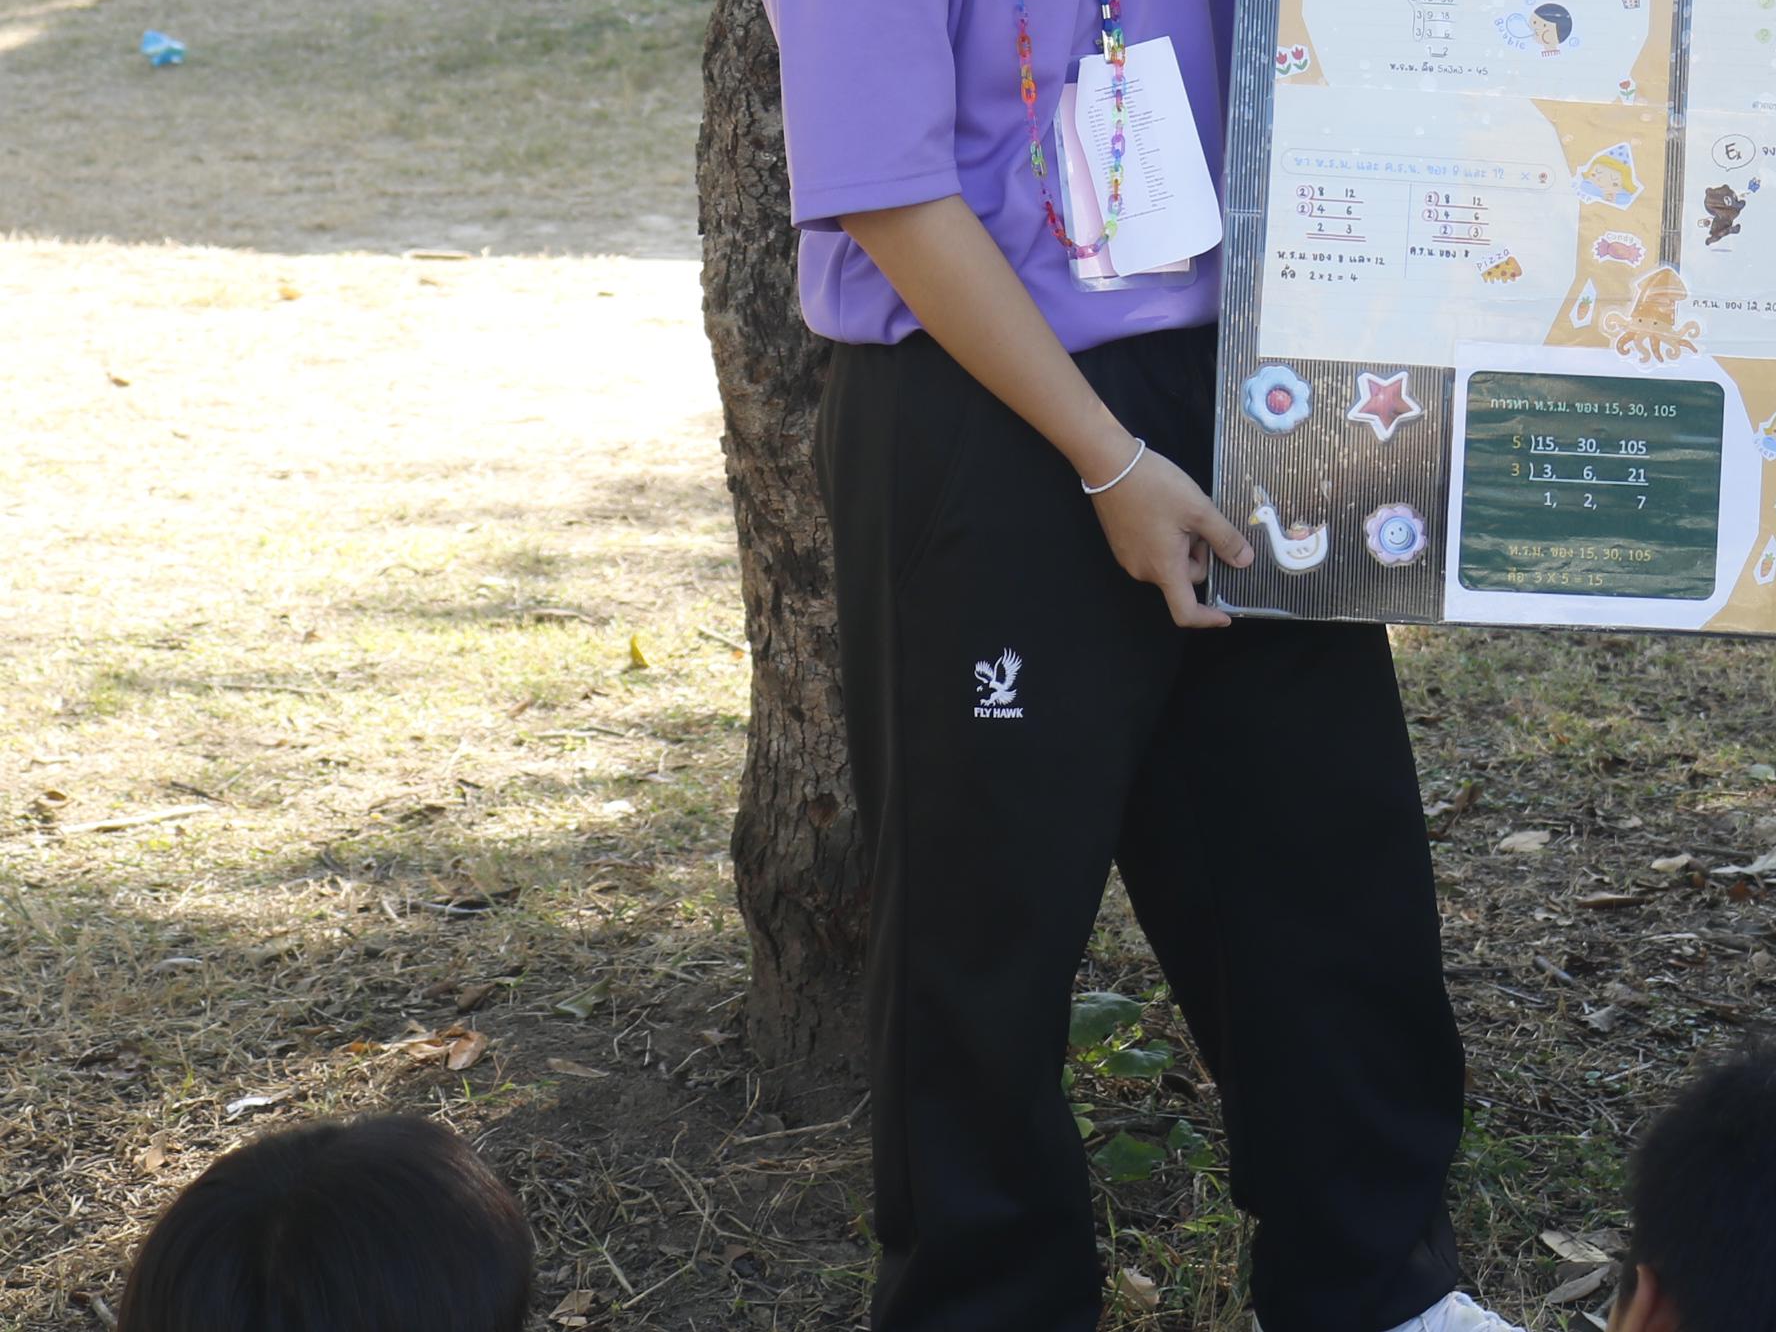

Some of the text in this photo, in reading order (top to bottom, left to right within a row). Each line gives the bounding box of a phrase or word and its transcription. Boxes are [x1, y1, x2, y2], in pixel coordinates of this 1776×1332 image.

[1426, 10, 1434, 20] 9
[1476, 66, 1489, 76] 45
[1318, 186, 1325, 196] 8
[1344, 188, 1356, 198] 12
[1472, 196, 1483, 206] 12
[1316, 204, 1326, 214] 4
[1346, 206, 1353, 216] 6
[1444, 210, 1450, 220] 4
[1317, 222, 1352, 234] 2 3
[1472, 227, 1479, 238] 3
[1375, 256, 1385, 266] 12
[1280, 264, 1358, 282] คือ 2 2 4
[1724, 301, 1743, 311] ของ
[1490, 396, 1677, 417] การหา ห.ร.ม. ของ 15, 30, 105
[1512, 435, 1647, 455] 5 15, 30, 105
[1511, 463, 1520, 477] 3
[1627, 468, 1647, 482] 21
[1543, 492, 1647, 511] 1, 2, 7
[1508, 546, 1652, 562] ห.ร.ม. ของ 15, 30, 105
[1507, 566, 1604, 586] คือ 3 5 15
[974, 707, 1024, 719] FLY HAWK
